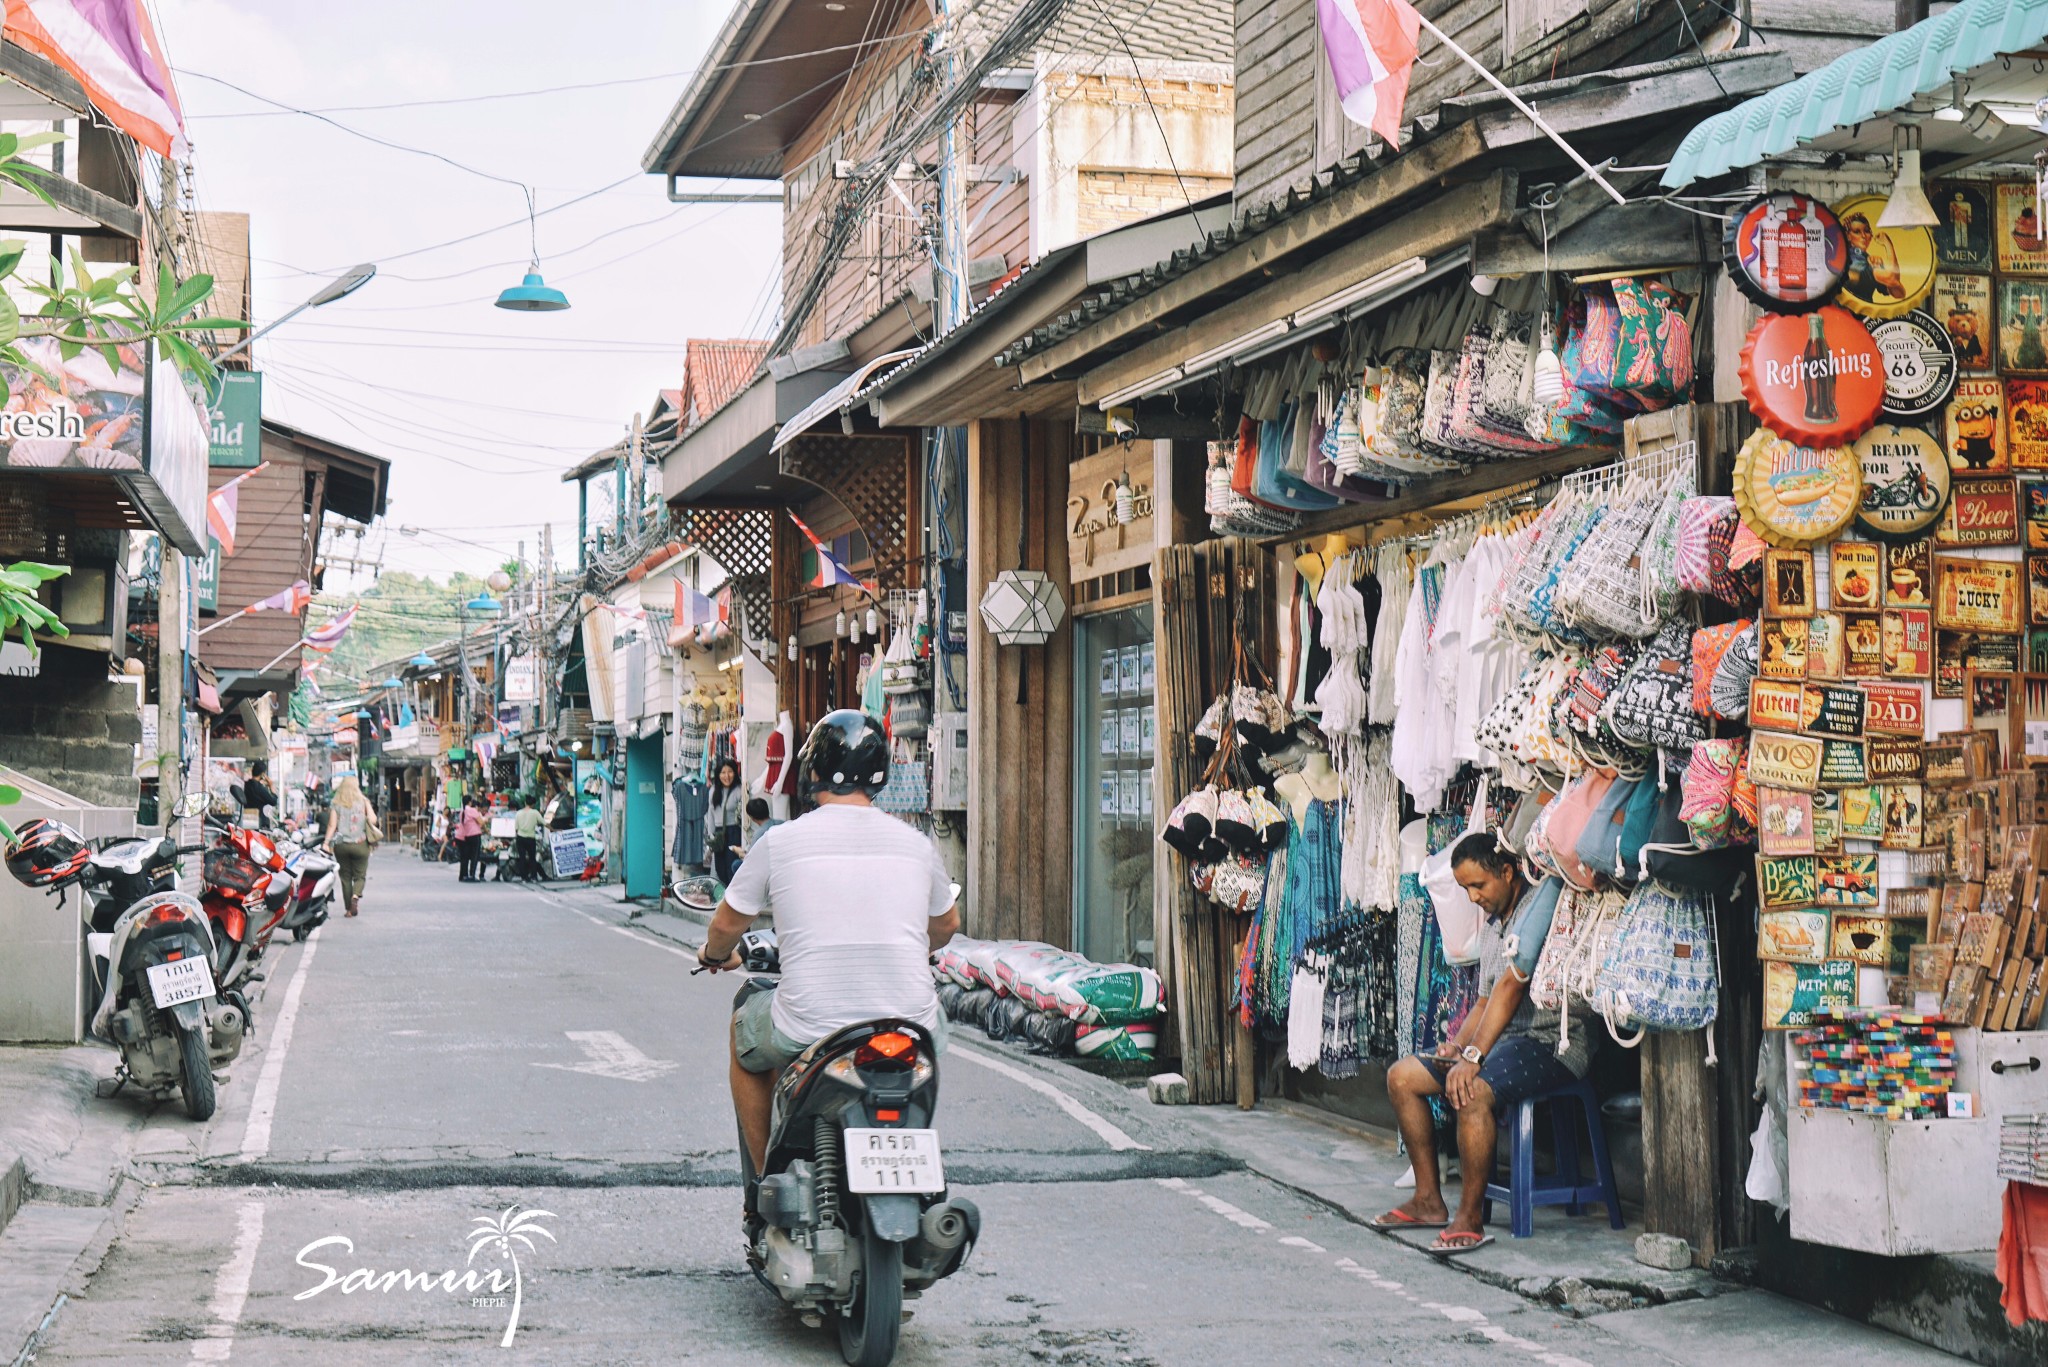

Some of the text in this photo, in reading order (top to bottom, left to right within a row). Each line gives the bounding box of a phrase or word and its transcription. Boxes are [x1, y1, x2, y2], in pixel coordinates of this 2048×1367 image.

[1946, 250, 1977, 261] MEN
[1885, 341, 1916, 351] ROUTE
[1765, 347, 1872, 390] Refreshing
[1891, 361, 1917, 377] 66
[1914, 372, 1949, 408] OKLAHOMA
[1871, 444, 1921, 457] READY
[1862, 462, 1889, 474] FOR
[1960, 484, 1977, 494] ICE
[1881, 510, 1916, 520] DUTY
[1960, 500, 2011, 527] Beer
[1960, 530, 1986, 541] SOLD
[1836, 552, 1876, 563] Pad Thai
[1959, 589, 2001, 609] LUCKY
[1907, 622, 1925, 632] MAKE
[1907, 631, 1919, 641] THE
[1907, 640, 1928, 652] RULES
[1828, 691, 1859, 703] SMILE
[1829, 701, 1857, 712] MORE
[1867, 701, 1917, 723] DAD
[1825, 712, 1859, 725] WORRY
[1829, 722, 1854, 733] LESS
[1756, 742, 1788, 763] NO
[1871, 752, 1921, 773] CLOSED
[1752, 768, 1814, 784] SMOKING
[1764, 857, 1815, 895] BEACH
[1819, 962, 1851, 976] SLEEP
[1797, 980, 1828, 992] WITH
[165, 984, 203, 1003] 3857
[1819, 995, 1849, 1008] FREE
[860, 1154, 929, 1169] สุราษฎร์ธานี
[875, 1170, 917, 1187] 111
